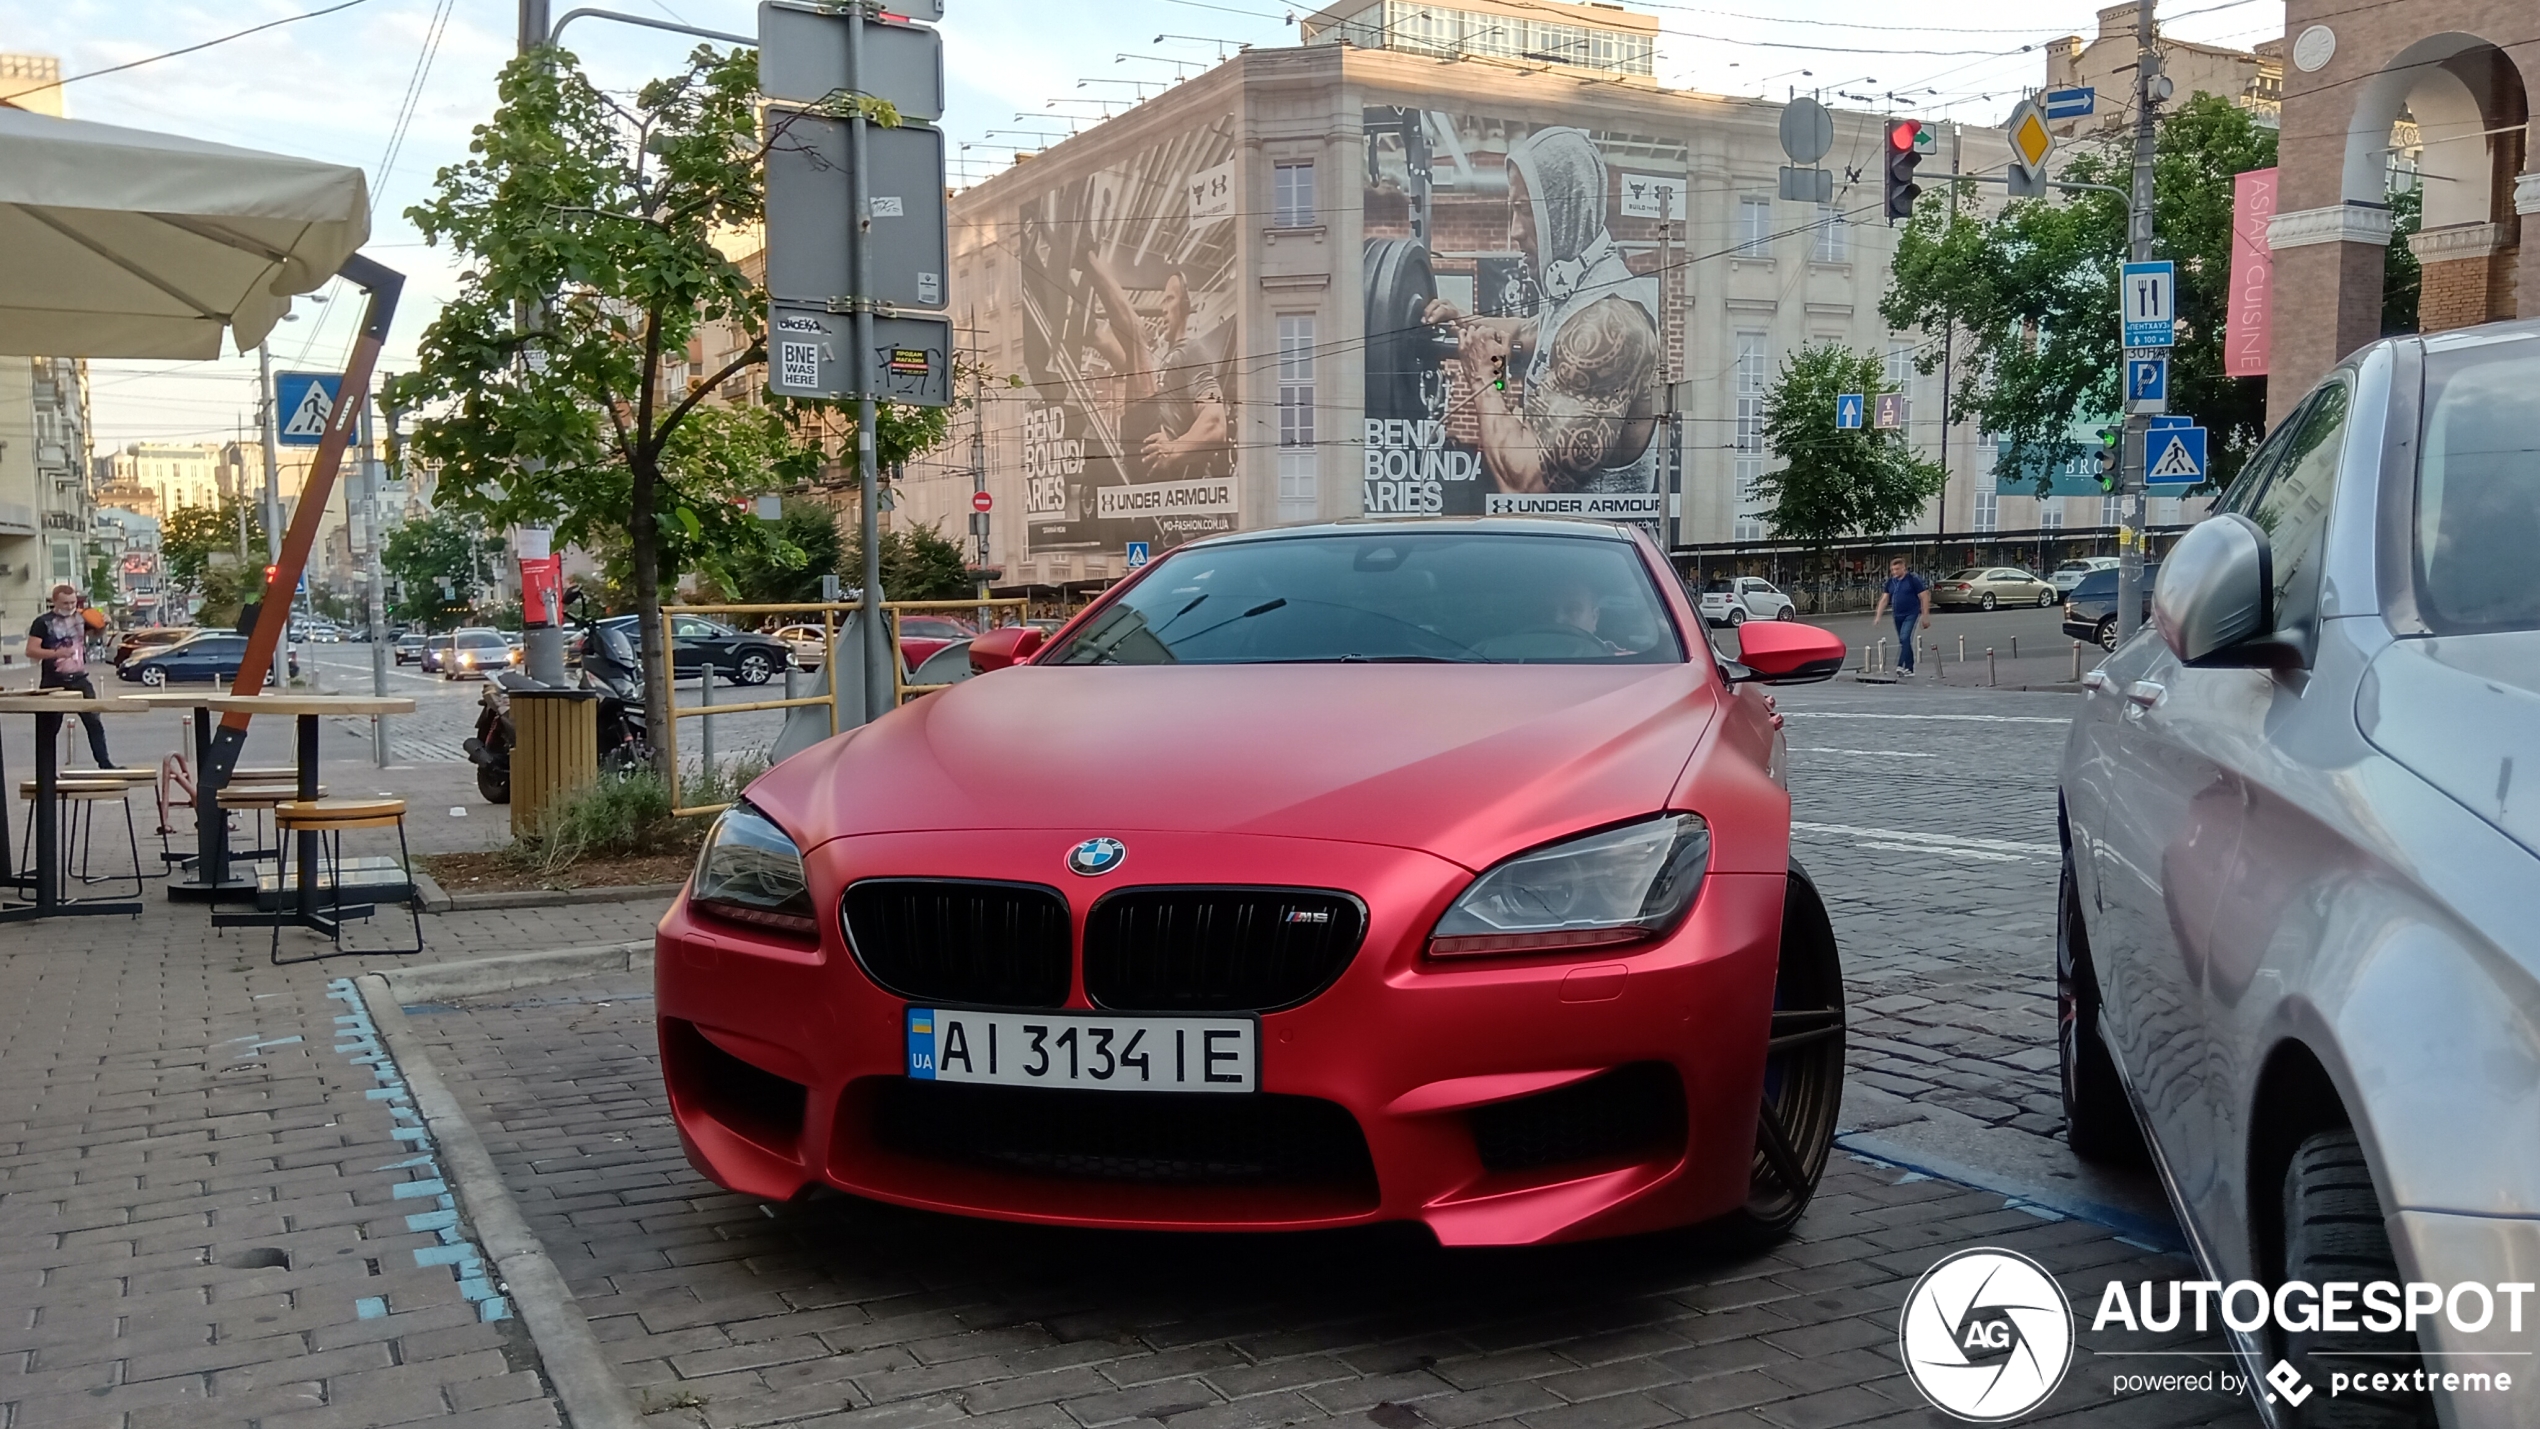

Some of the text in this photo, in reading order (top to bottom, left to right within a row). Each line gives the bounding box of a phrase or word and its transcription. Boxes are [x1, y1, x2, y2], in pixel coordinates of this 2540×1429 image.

[1628, 203, 1646, 211] BUILD
[2241, 179, 2270, 368] ASIAN CUISINE
[2143, 335, 2157, 344] 100
[785, 345, 815, 364] BNE
[785, 363, 815, 375] WAS
[785, 374, 816, 386] HERE
[1025, 406, 1066, 445] BEND
[1364, 418, 1446, 450] BEND
[1117, 486, 1229, 510] UNDER ARMOUR
[1364, 481, 1444, 512] ARIES
[1518, 499, 1582, 513] UNDER
[1163, 519, 1229, 531] MD-FASHION.COM.UA
[940, 1021, 1243, 1083] AI 3134 IE
[912, 1053, 933, 1071] UA
